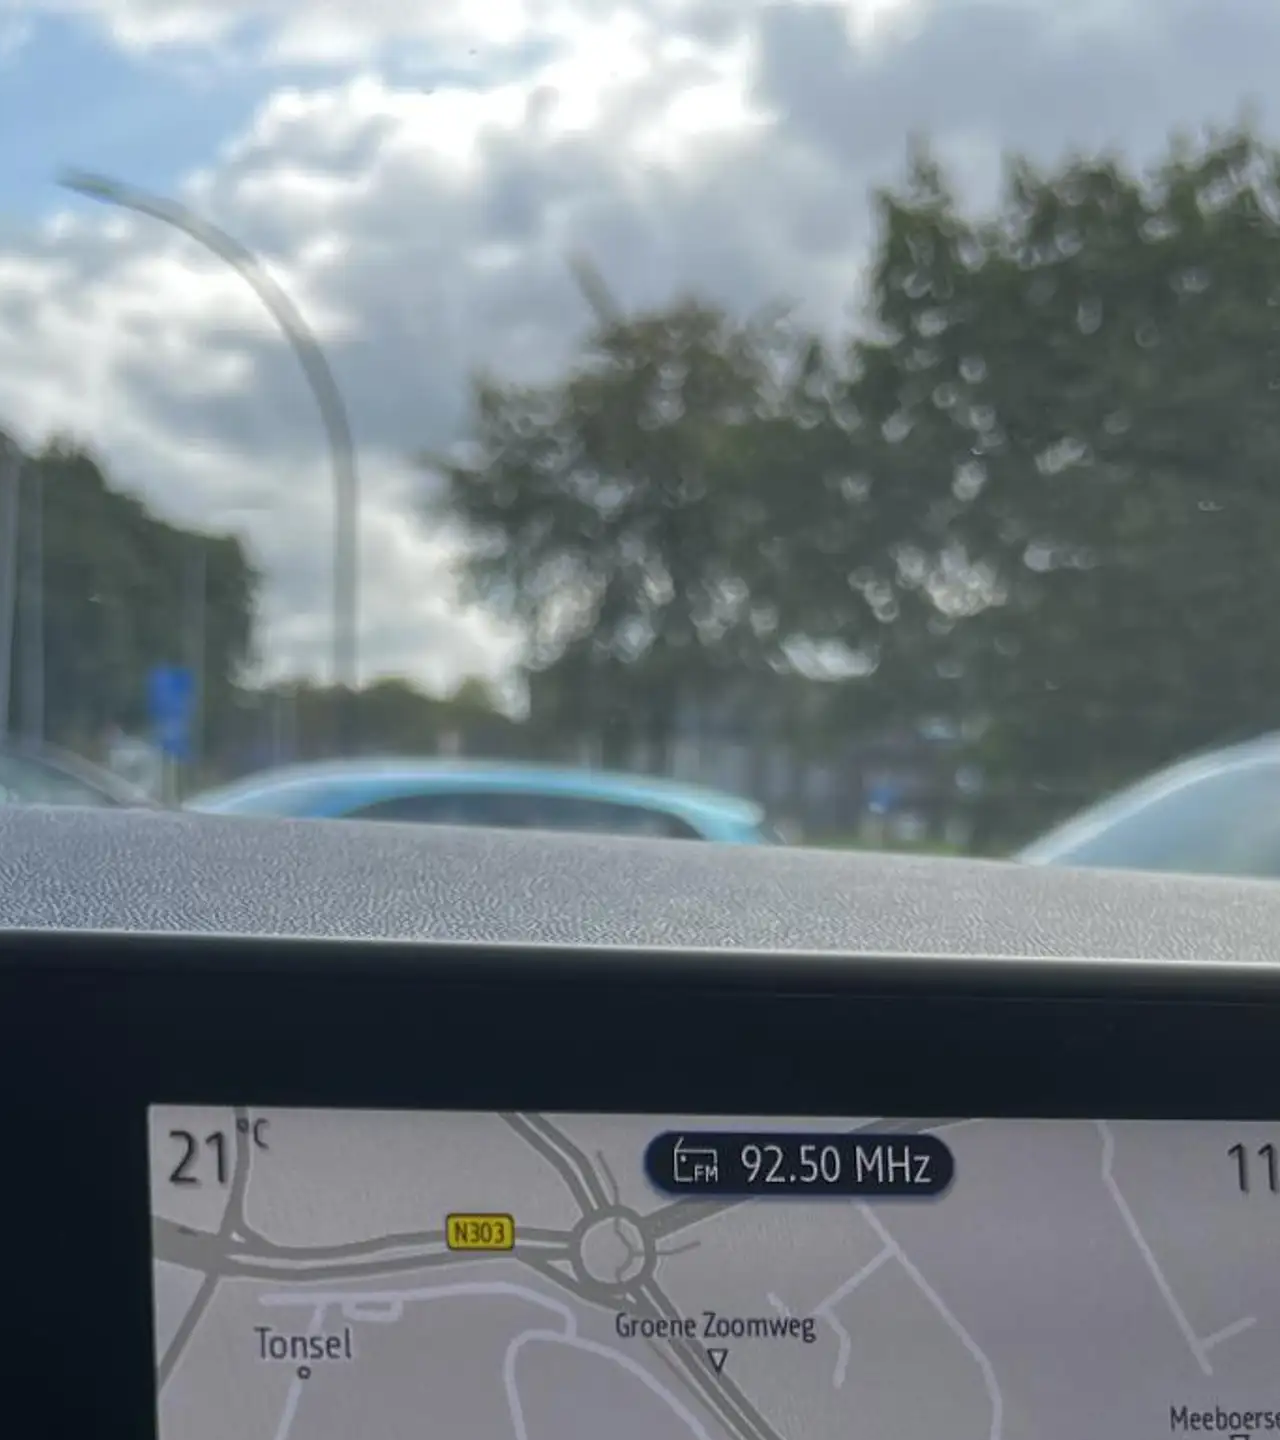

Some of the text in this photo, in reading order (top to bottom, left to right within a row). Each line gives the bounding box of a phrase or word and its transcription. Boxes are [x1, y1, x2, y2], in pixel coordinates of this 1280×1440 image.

[694, 1145, 932, 1183] FM 92.50 MHz
[454, 1220, 504, 1246] N303
[254, 1326, 353, 1360] Tonsel
[615, 1312, 816, 1343] Groene Zoomweg
